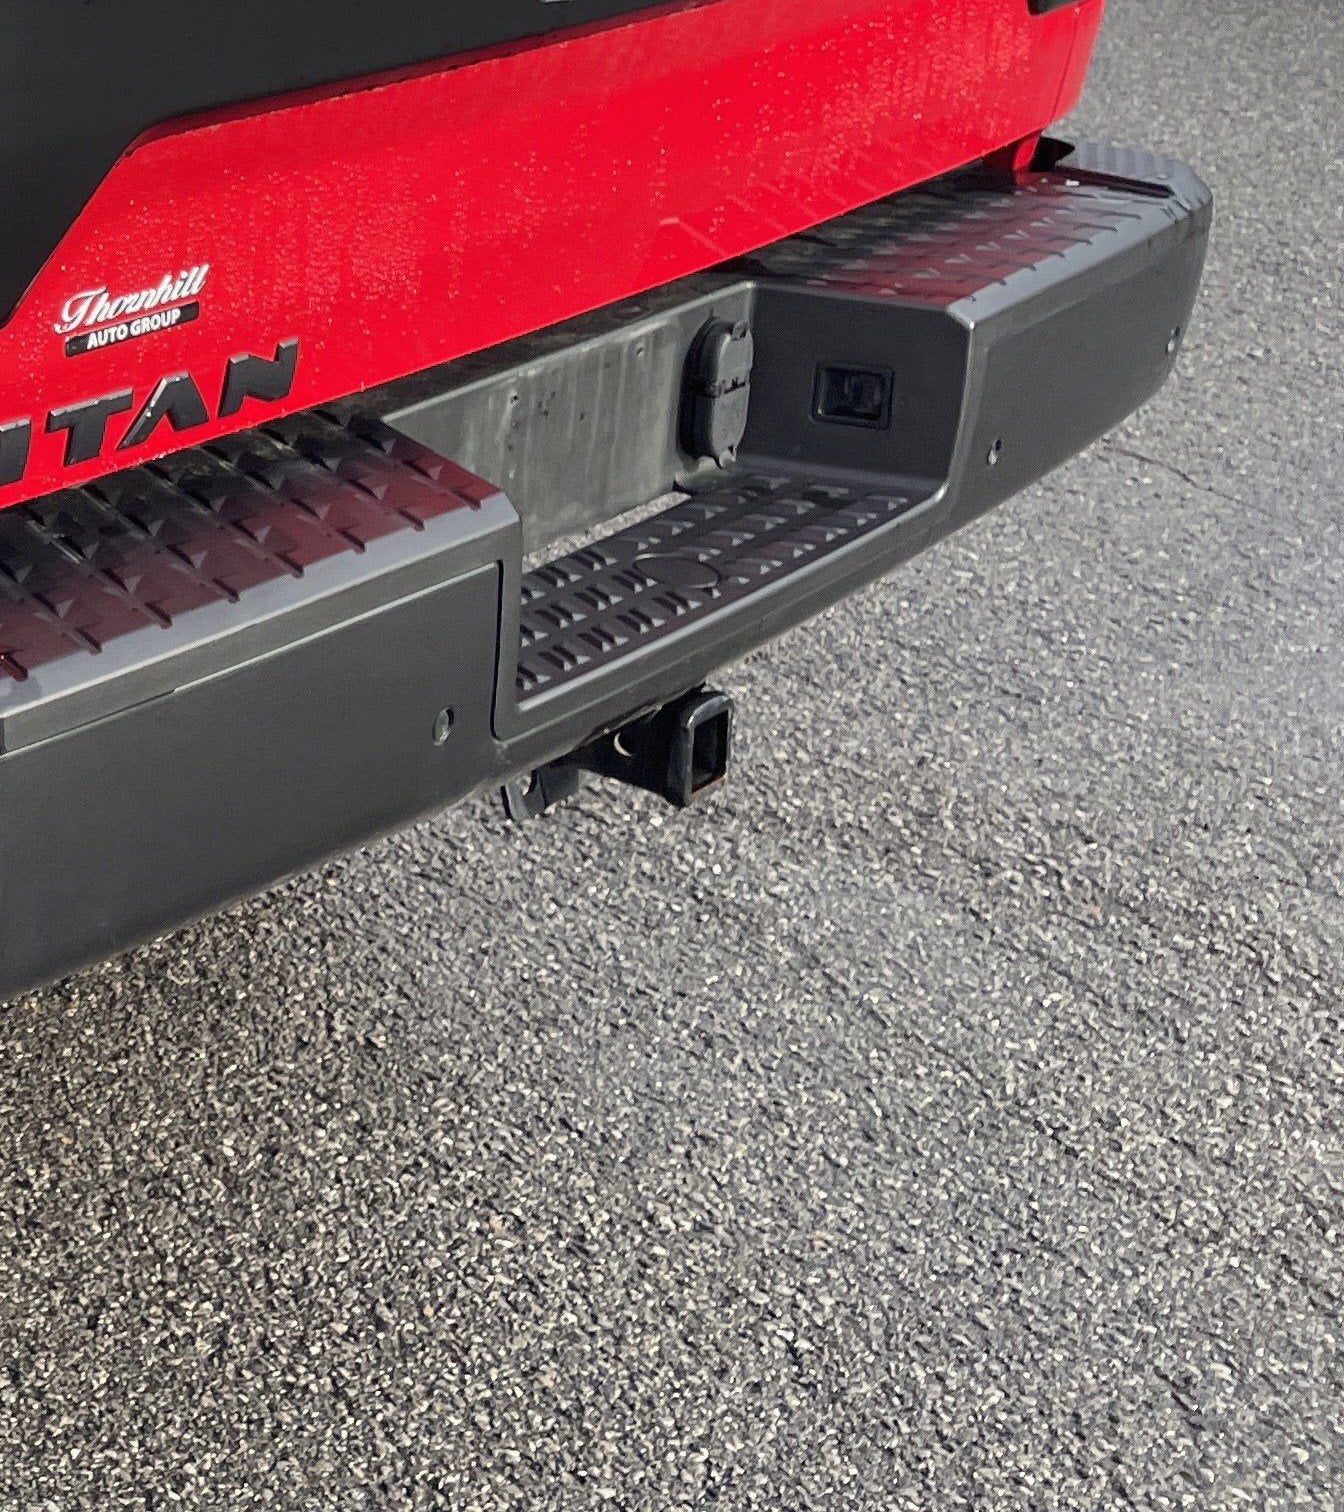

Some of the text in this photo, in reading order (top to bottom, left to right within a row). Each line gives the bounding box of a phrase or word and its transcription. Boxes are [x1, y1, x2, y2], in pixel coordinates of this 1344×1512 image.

[54, 264, 210, 334] Thornhill
[86, 308, 182, 349] AUTO GROUP
